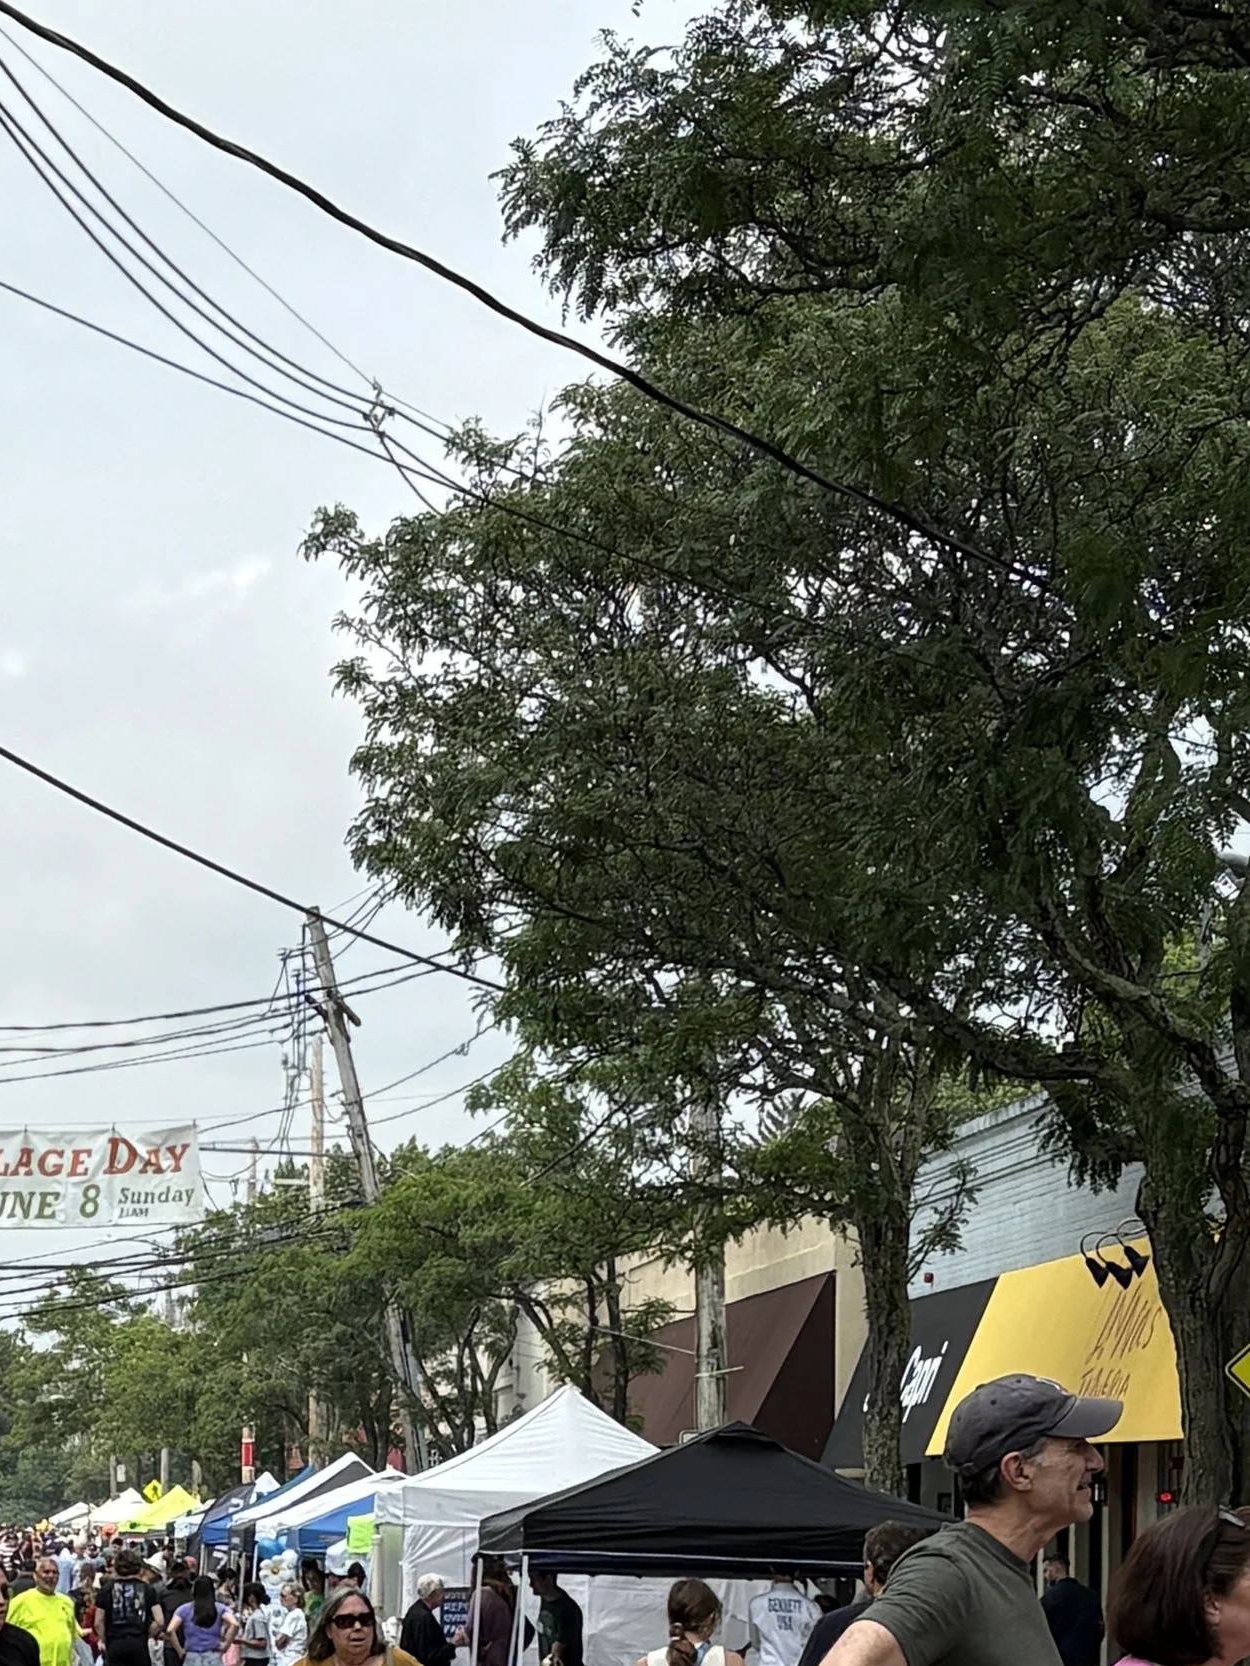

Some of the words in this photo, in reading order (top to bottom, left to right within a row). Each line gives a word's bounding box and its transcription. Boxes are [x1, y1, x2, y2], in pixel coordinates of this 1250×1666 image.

[102, 1136, 191, 1175] DAY
[79, 1183, 101, 1219] 8
[117, 1185, 195, 1207] Sunday
[899, 1340, 949, 1424] Capri
